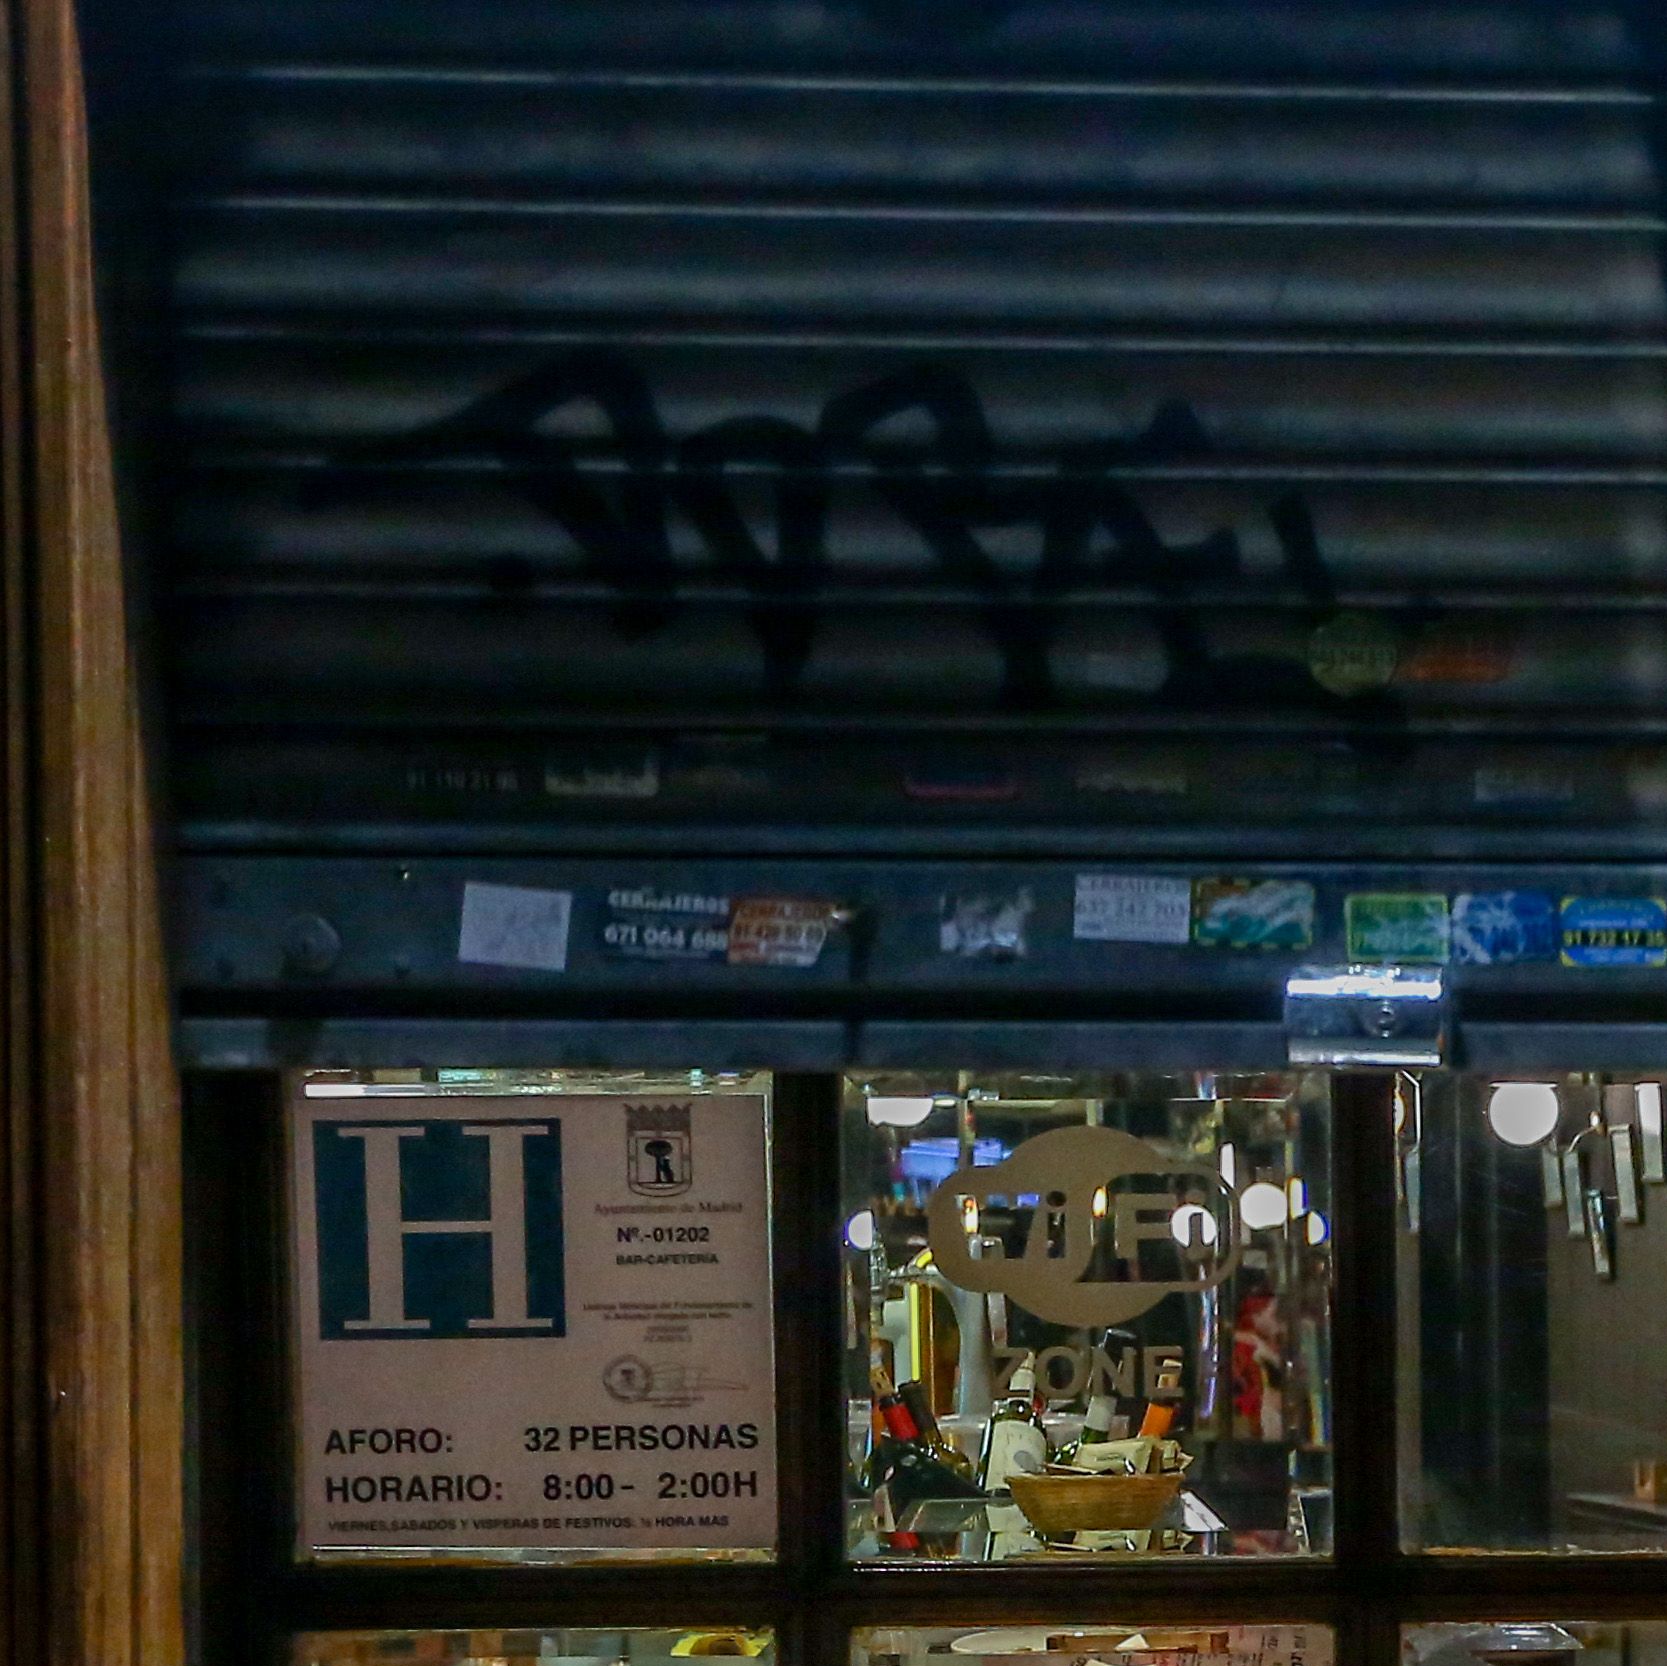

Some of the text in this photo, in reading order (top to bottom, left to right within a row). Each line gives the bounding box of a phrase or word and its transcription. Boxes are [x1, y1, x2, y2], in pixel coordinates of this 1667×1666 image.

[336, 1125, 556, 1331] H
[992, 1345, 1185, 1399] ZONE
[324, 1423, 760, 1455] AFORO: 32 PERSONAS
[325, 1475, 504, 1503] HORARIO:
[542, 1473, 615, 1501] 8:00
[655, 1515, 695, 1529] HORA
